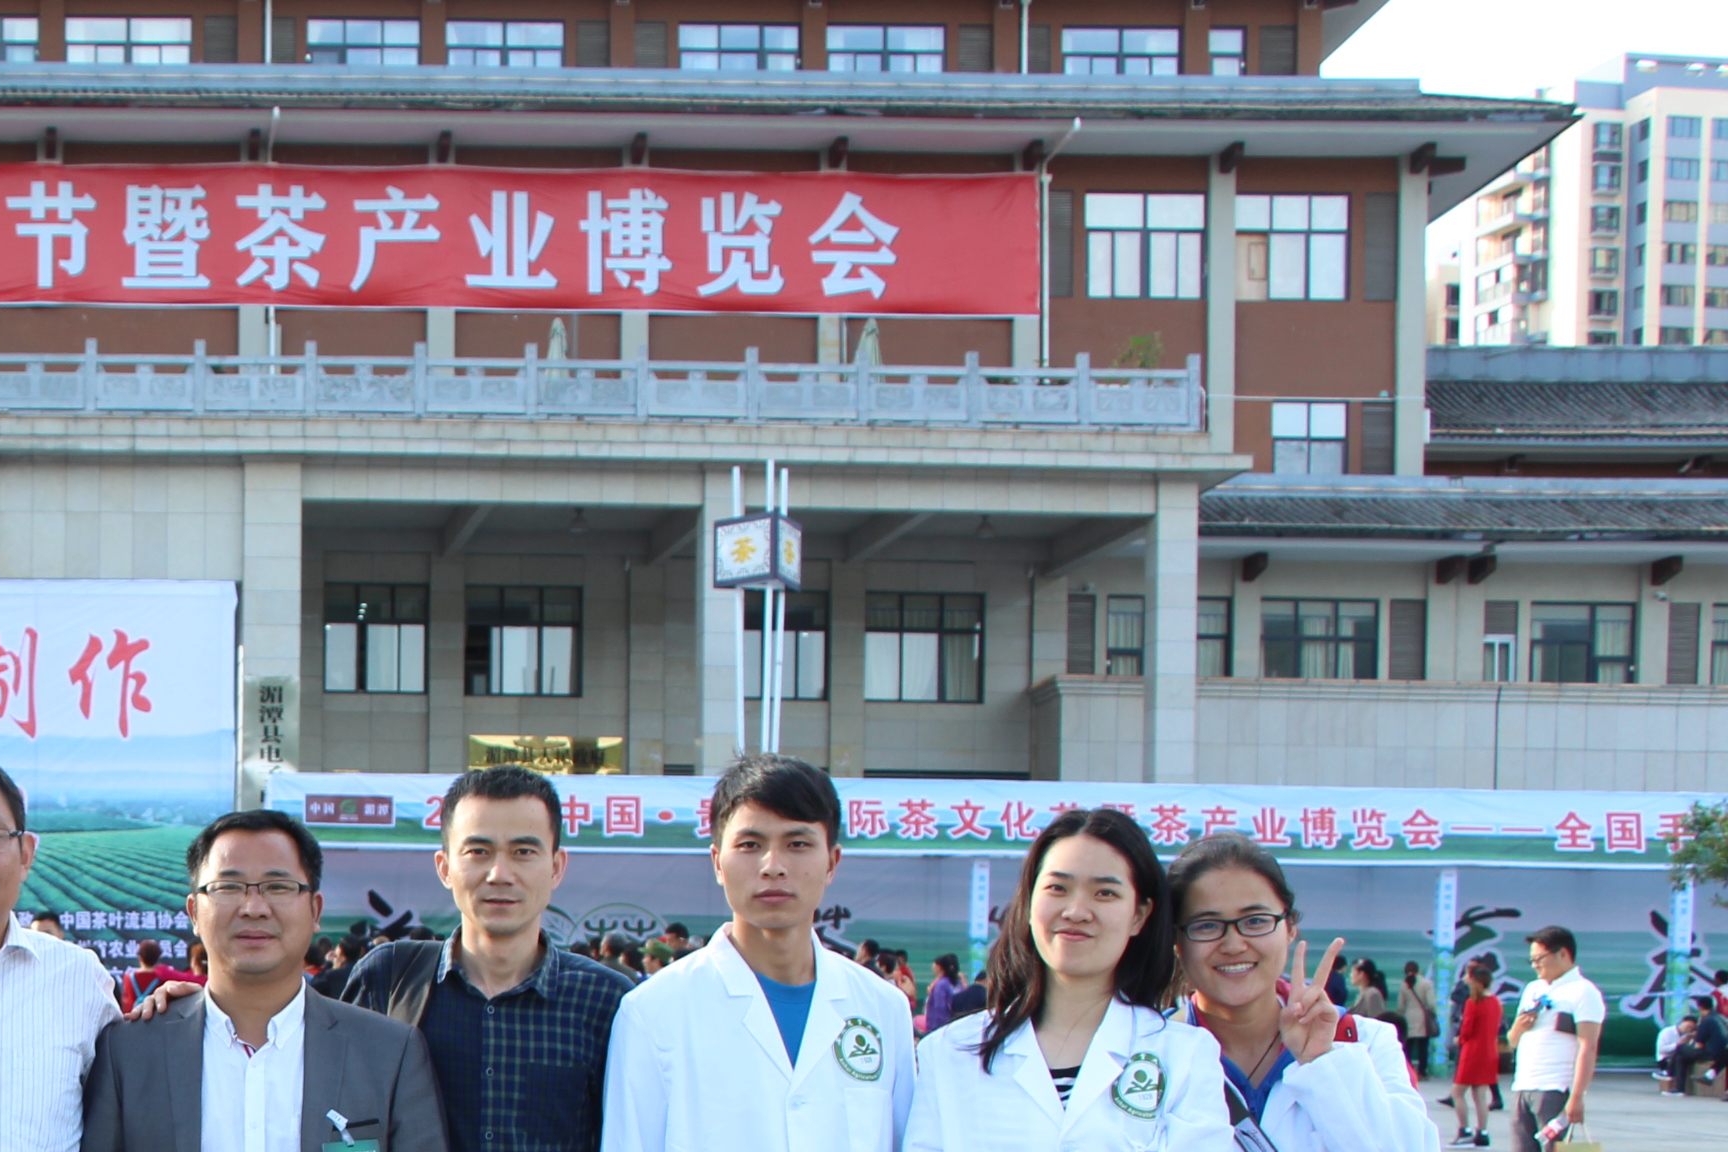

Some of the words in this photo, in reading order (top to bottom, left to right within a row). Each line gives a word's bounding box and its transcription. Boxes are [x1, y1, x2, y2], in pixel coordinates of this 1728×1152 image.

[59, 911, 189, 930] 中国茶叶流通协会
